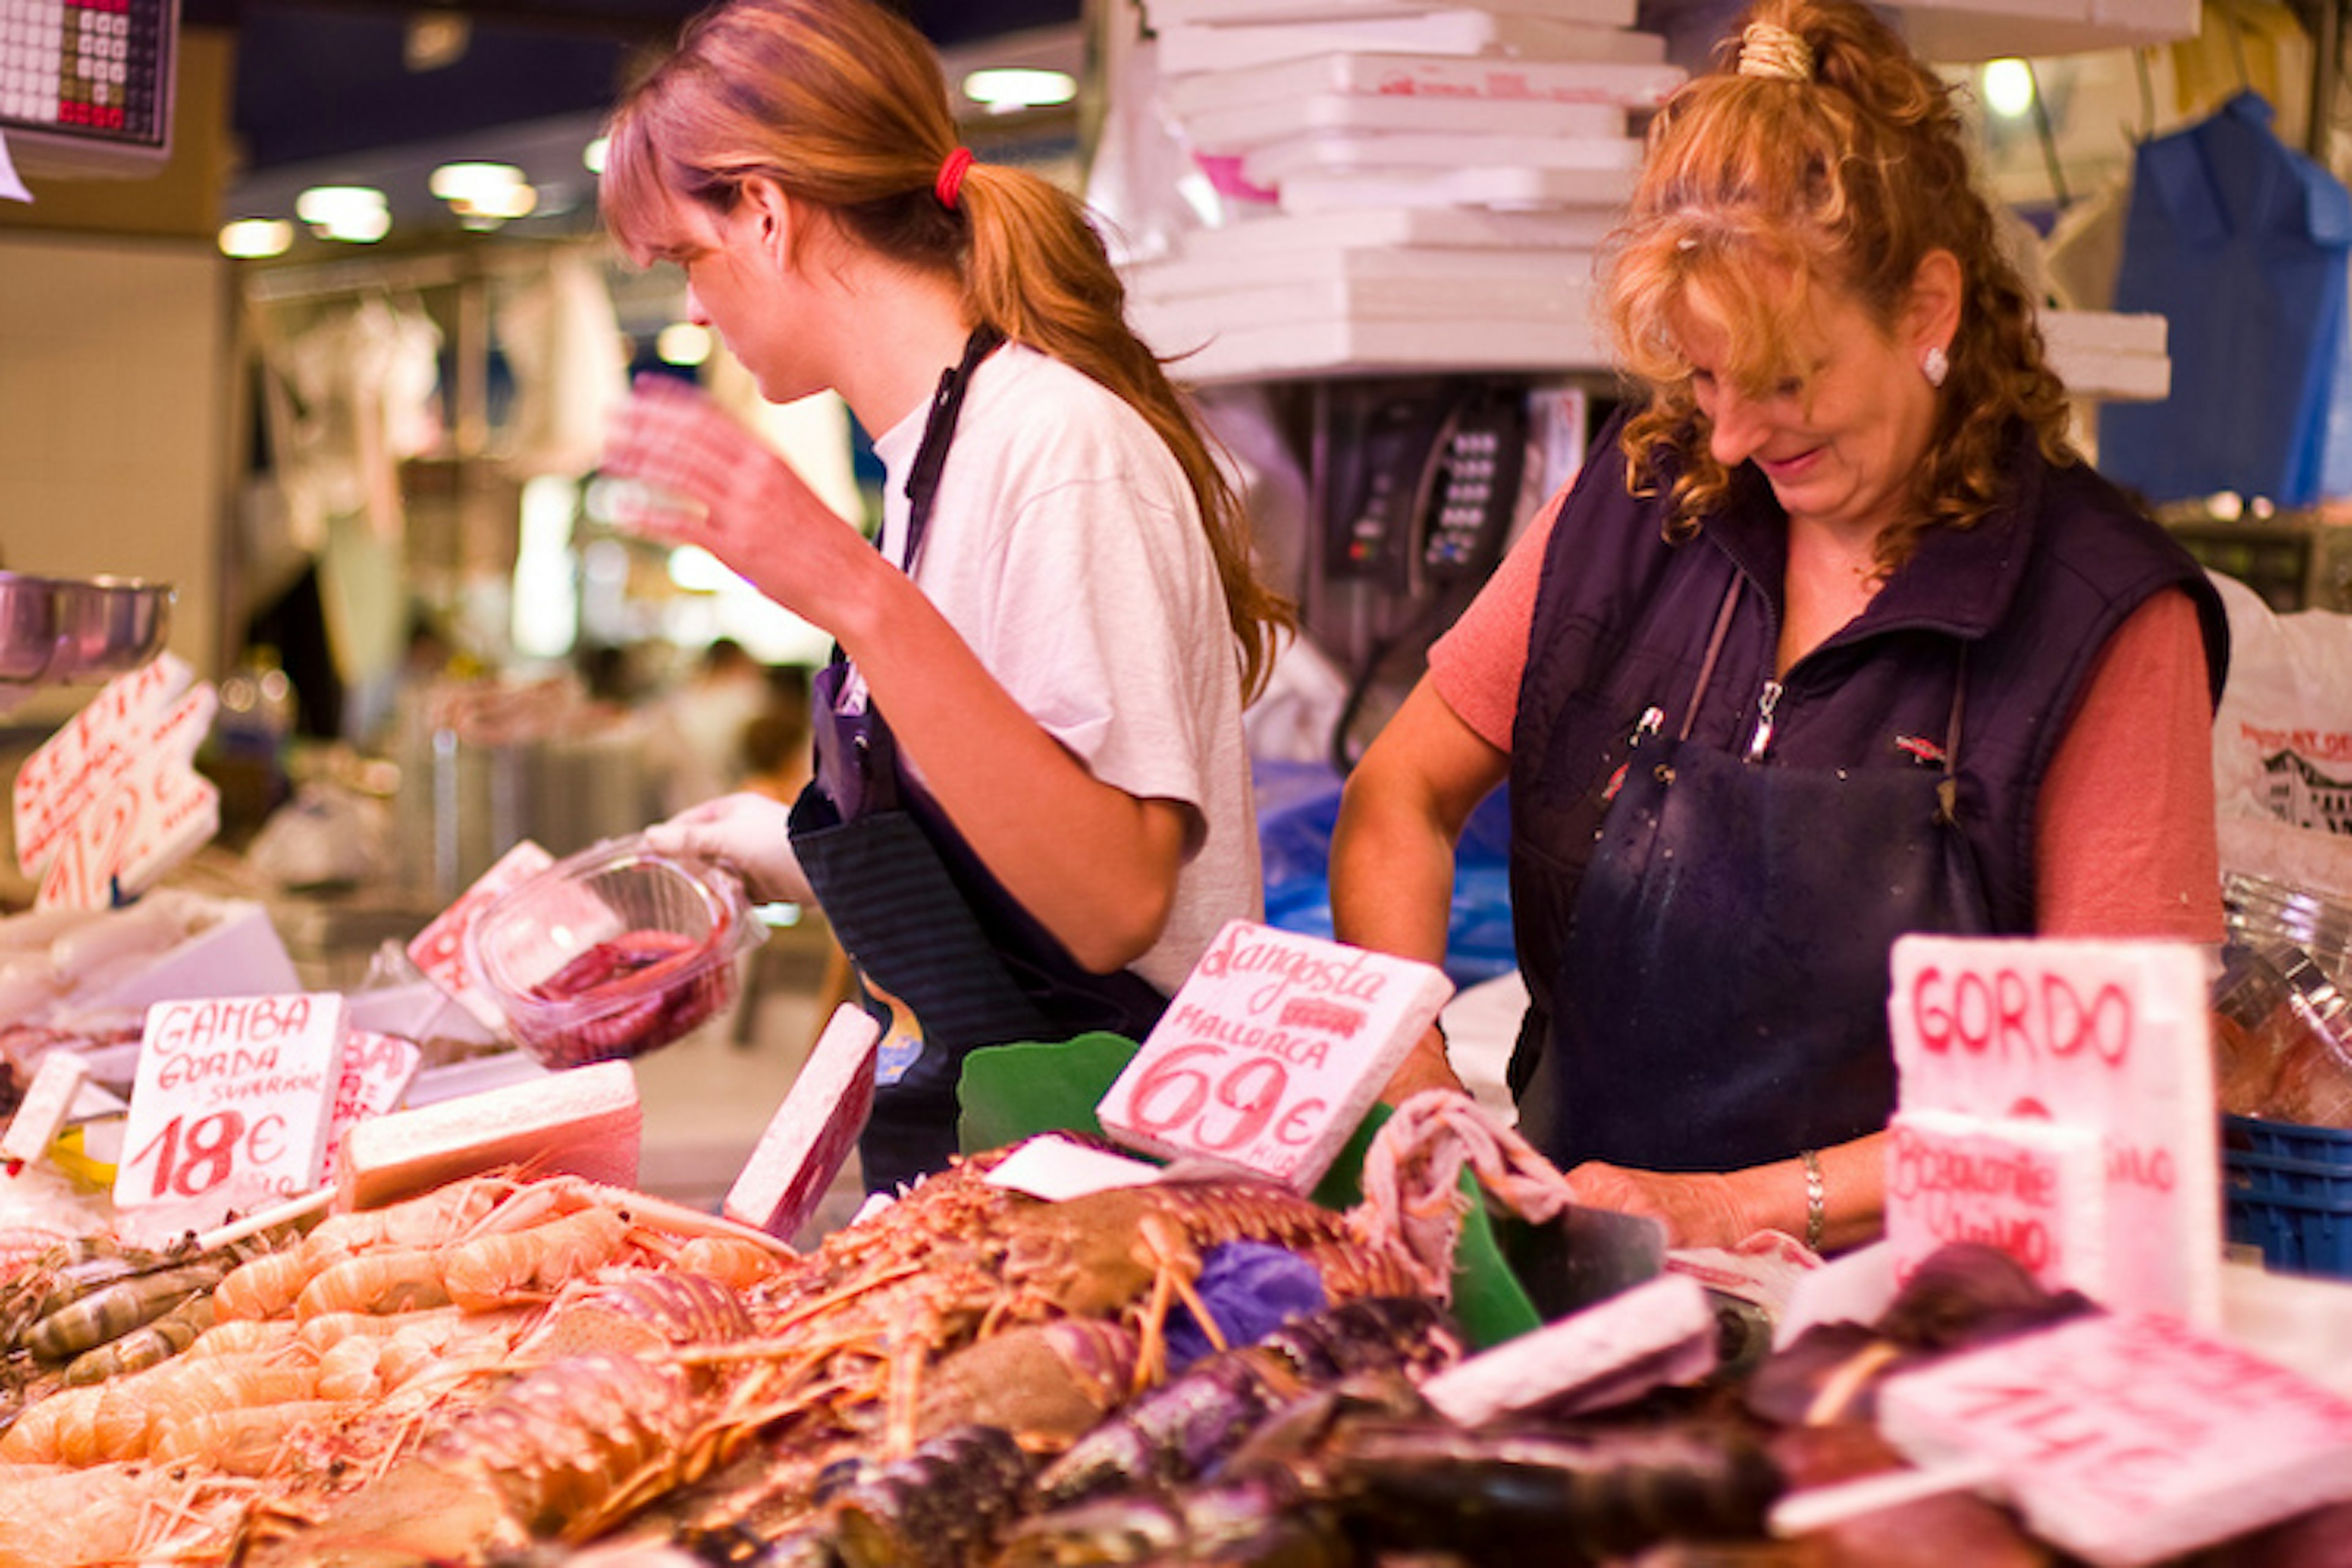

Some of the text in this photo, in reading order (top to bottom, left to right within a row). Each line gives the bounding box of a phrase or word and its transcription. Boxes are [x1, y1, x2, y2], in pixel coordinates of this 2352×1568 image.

[1200, 925, 1387, 1016] Langosta
[153, 996, 311, 1056] GAMBA
[1174, 1003, 1331, 1070] MALLORCA
[1913, 965, 2133, 1070] GORDO
[159, 1046, 280, 1090] GORDA
